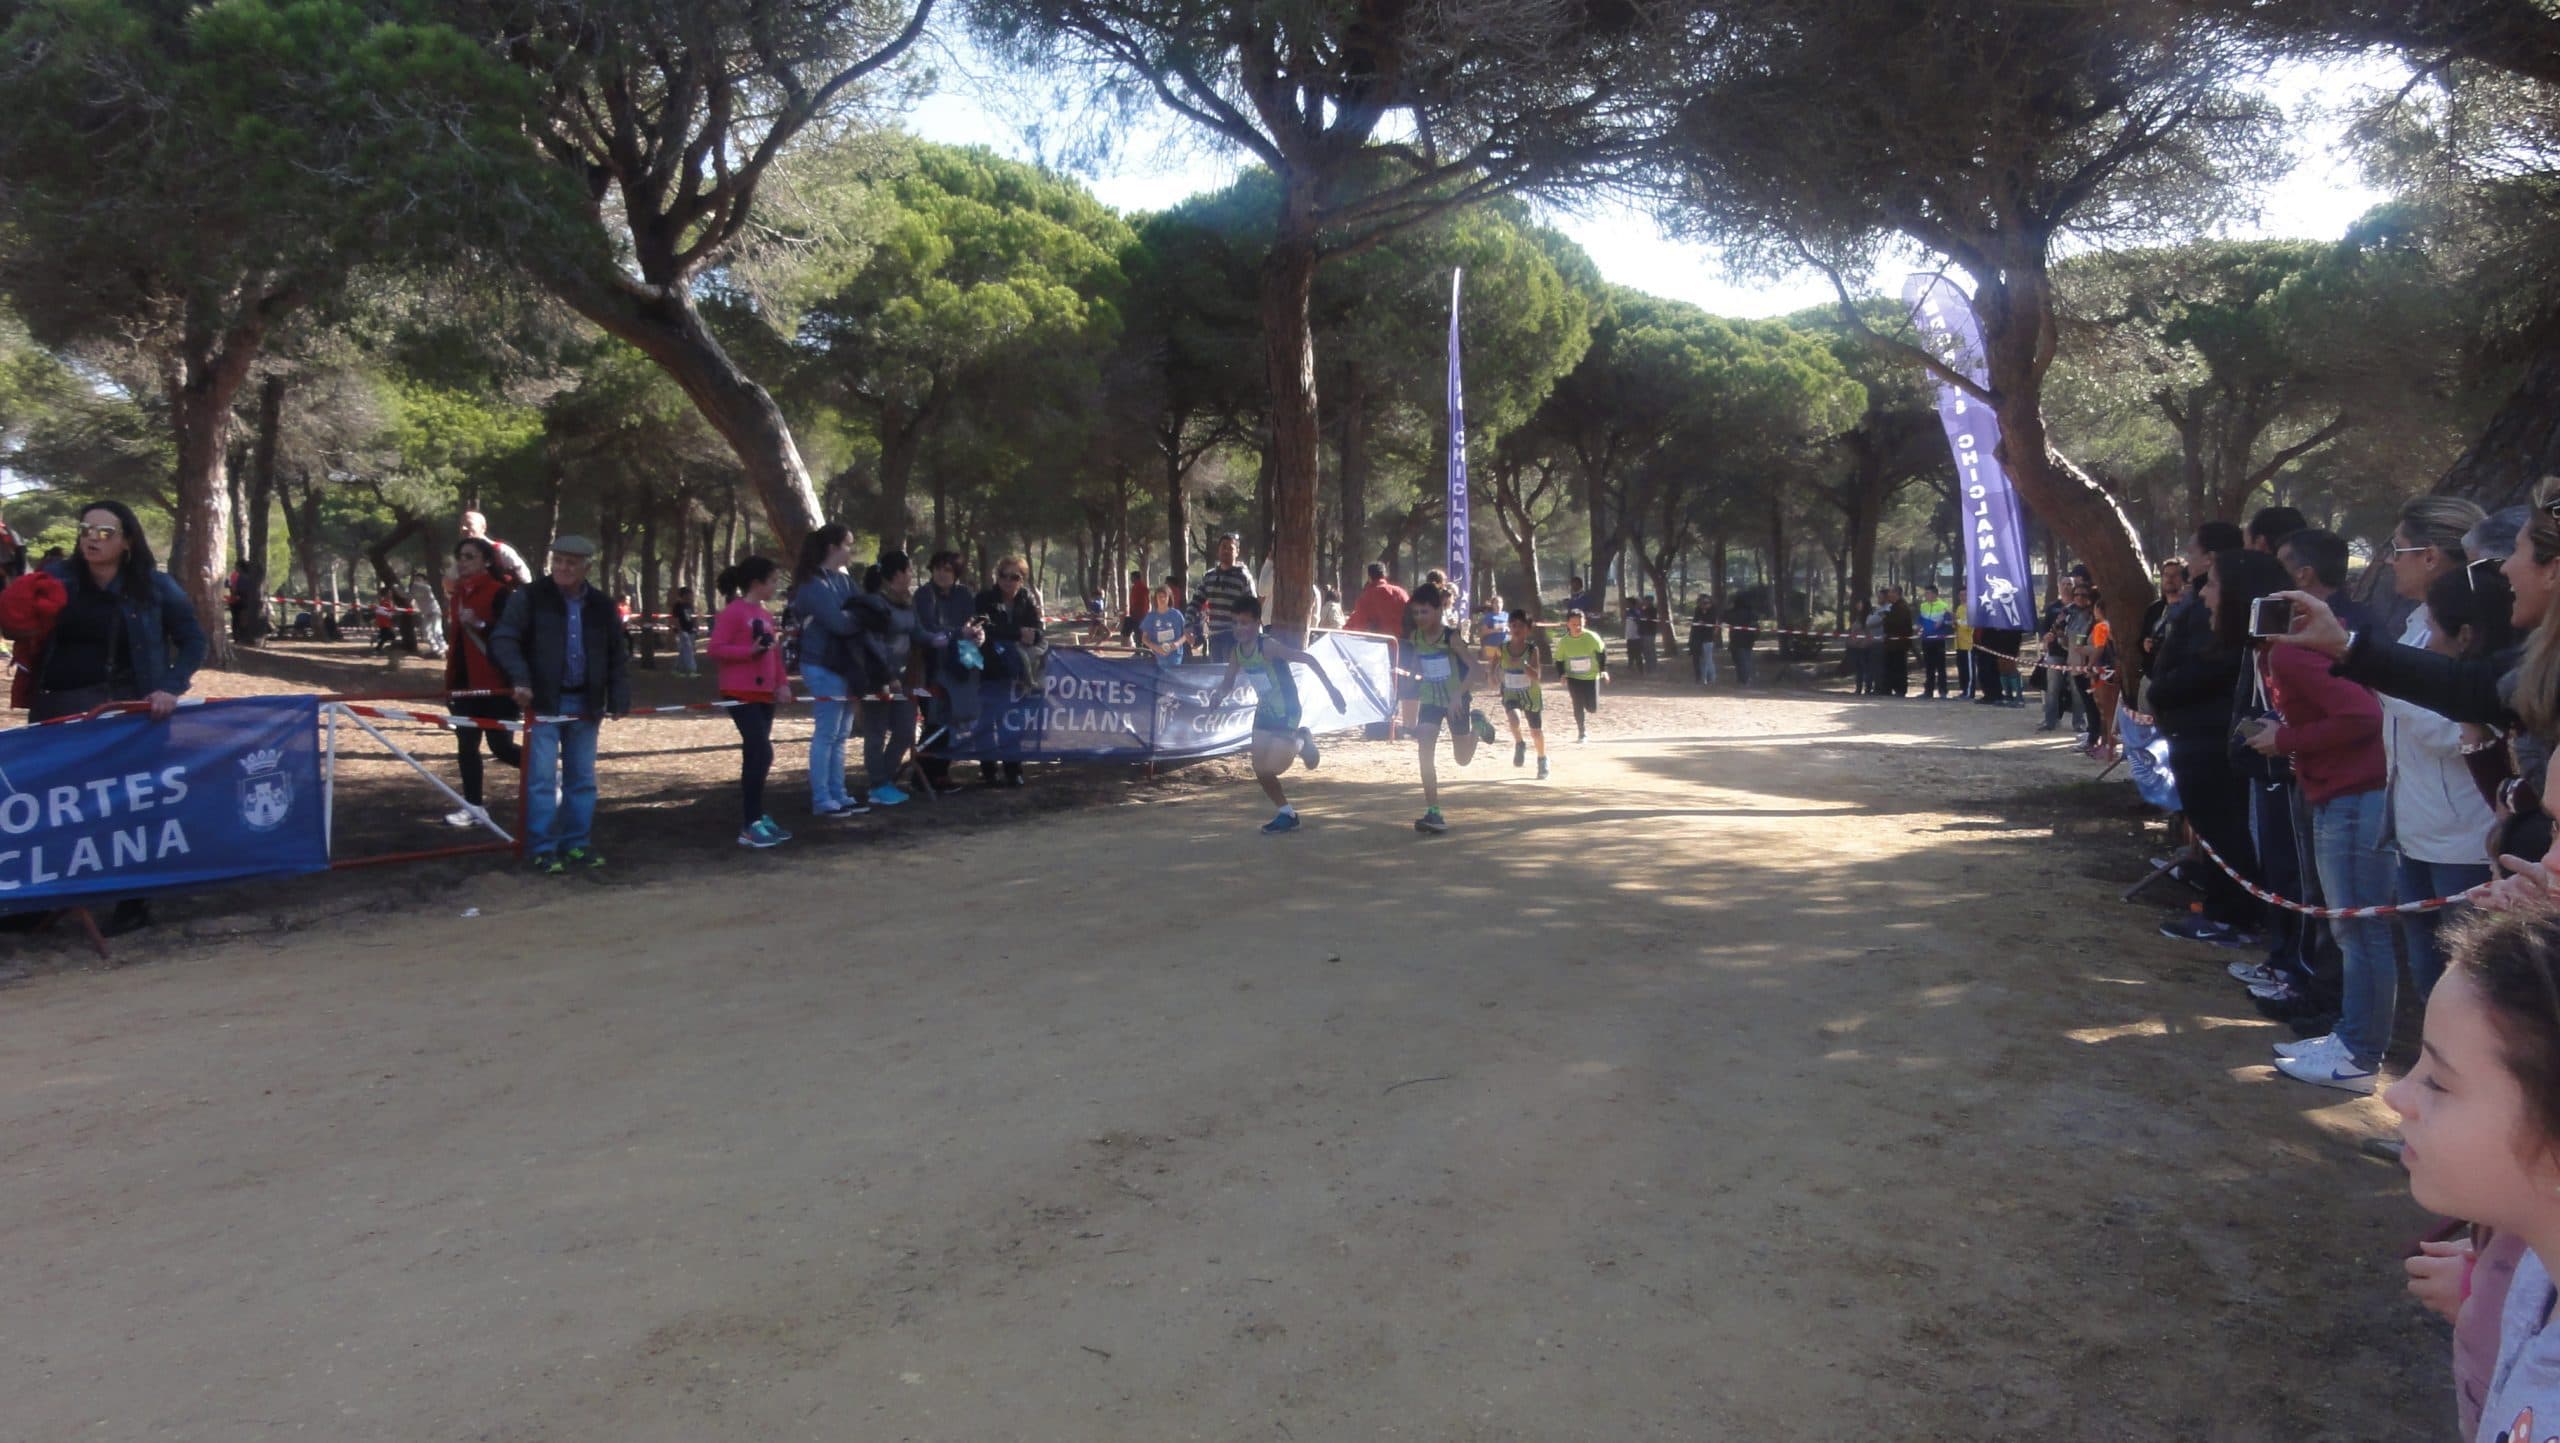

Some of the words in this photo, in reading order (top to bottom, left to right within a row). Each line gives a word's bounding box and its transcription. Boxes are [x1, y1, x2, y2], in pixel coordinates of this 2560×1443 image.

[1453, 431, 1465, 564] CHICLANA
[1002, 707, 1137, 734] CHICLANA
[0, 766, 189, 834] ORTES
